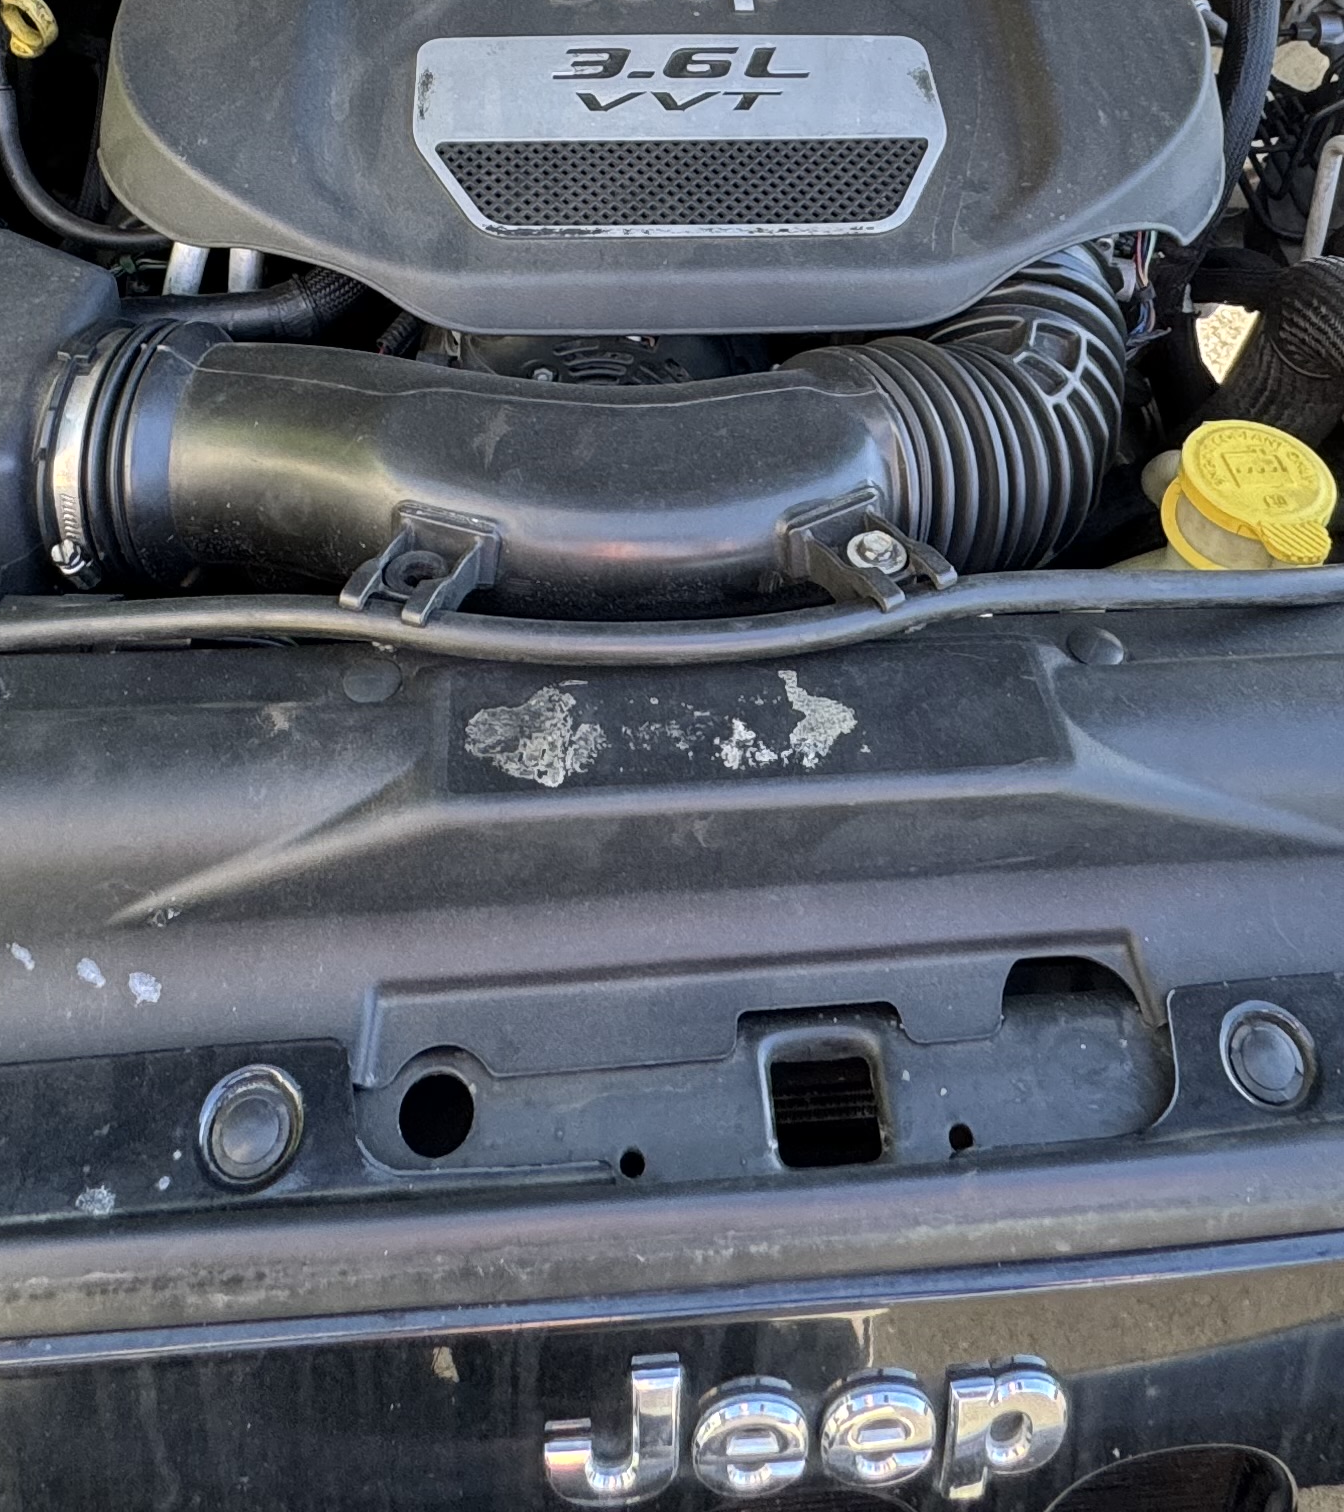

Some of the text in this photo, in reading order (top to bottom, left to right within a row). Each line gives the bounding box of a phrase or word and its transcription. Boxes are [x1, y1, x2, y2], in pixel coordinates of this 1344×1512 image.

[552, 47, 810, 79] 3.6L
[576, 91, 783, 112] VVT
[544, 1352, 1069, 1508] Jeep
